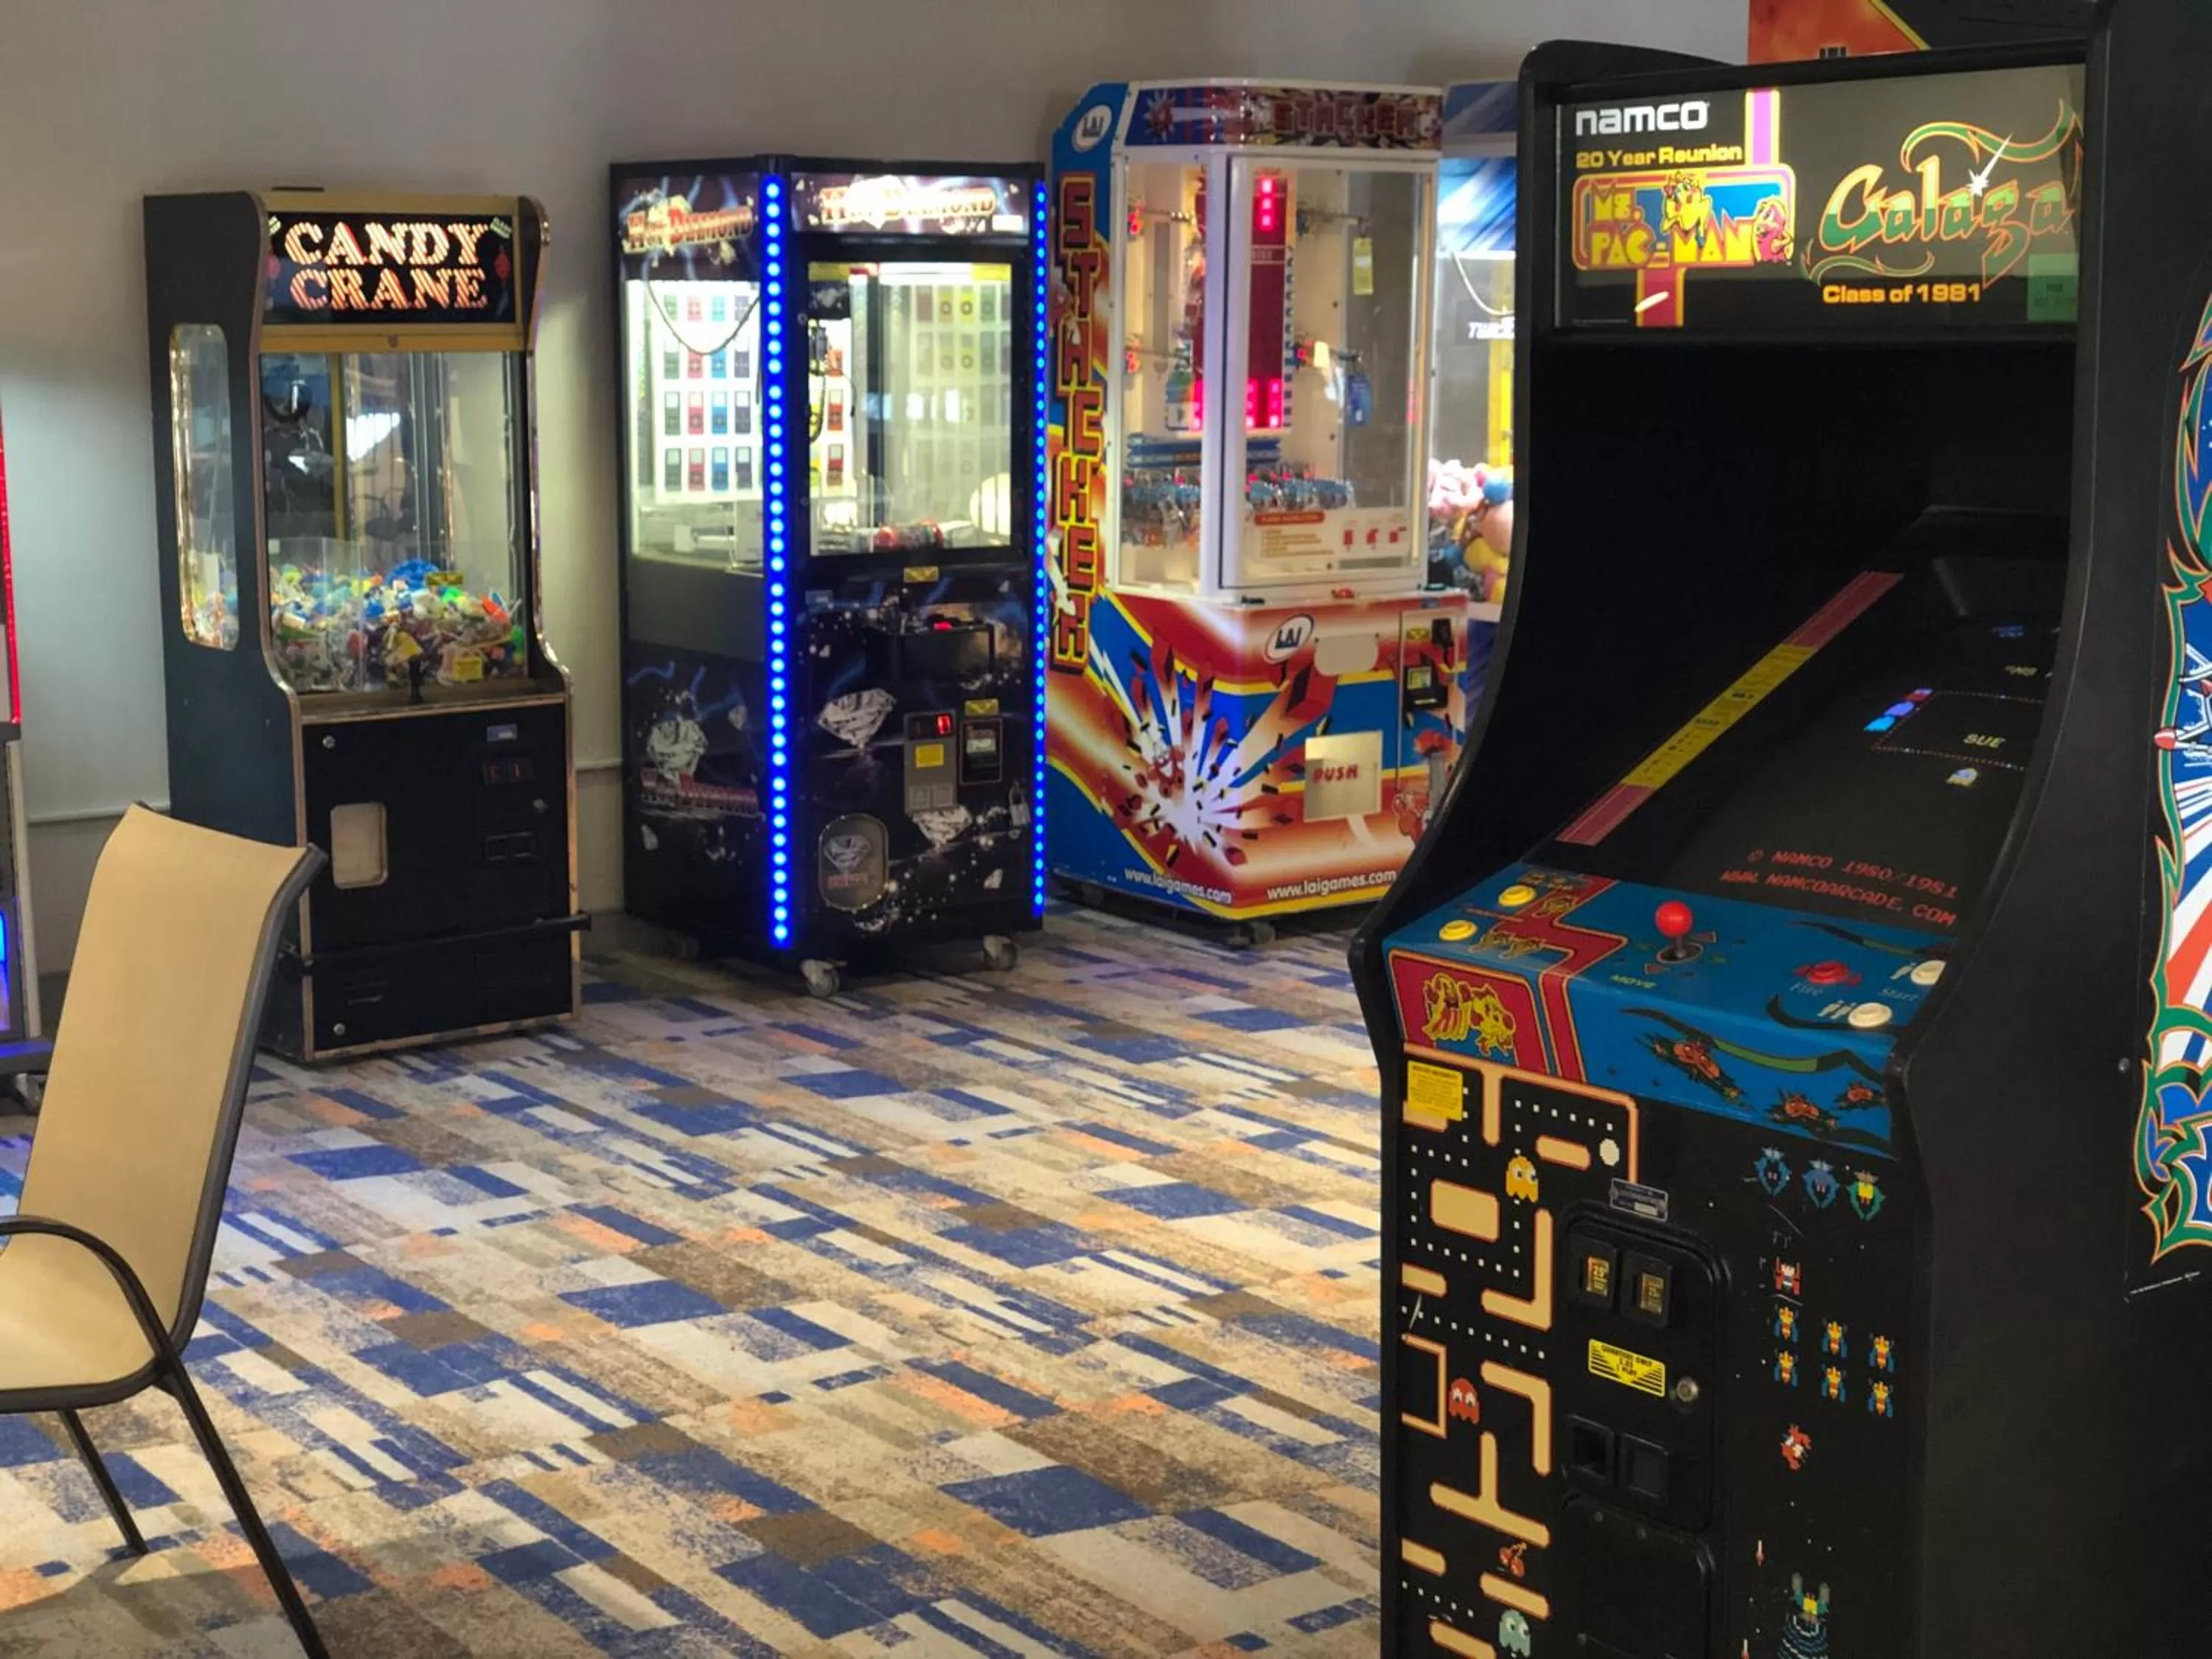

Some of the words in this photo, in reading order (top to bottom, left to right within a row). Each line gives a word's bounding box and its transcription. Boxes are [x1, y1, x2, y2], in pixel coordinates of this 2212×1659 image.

[1270, 100, 1420, 138] STACKER
[1576, 100, 1708, 136] namco
[1576, 150, 1604, 169] 20
[1608, 149, 1656, 167] Year
[1658, 143, 1743, 165] Reunion
[285, 221, 489, 265] CANDY
[290, 268, 488, 310] CRANE
[1822, 285, 1885, 304] Class
[1889, 285, 1914, 303] of
[1917, 283, 1982, 302] 1981
[1051, 175, 1104, 668] STACKER
[1963, 733, 2006, 749] SUE
[1312, 764, 1359, 783] PUSH
[1771, 851, 1834, 869] NAMCO
[1124, 867, 1232, 905] www.laigames.com
[1267, 869, 1397, 900] www.laigames.com
